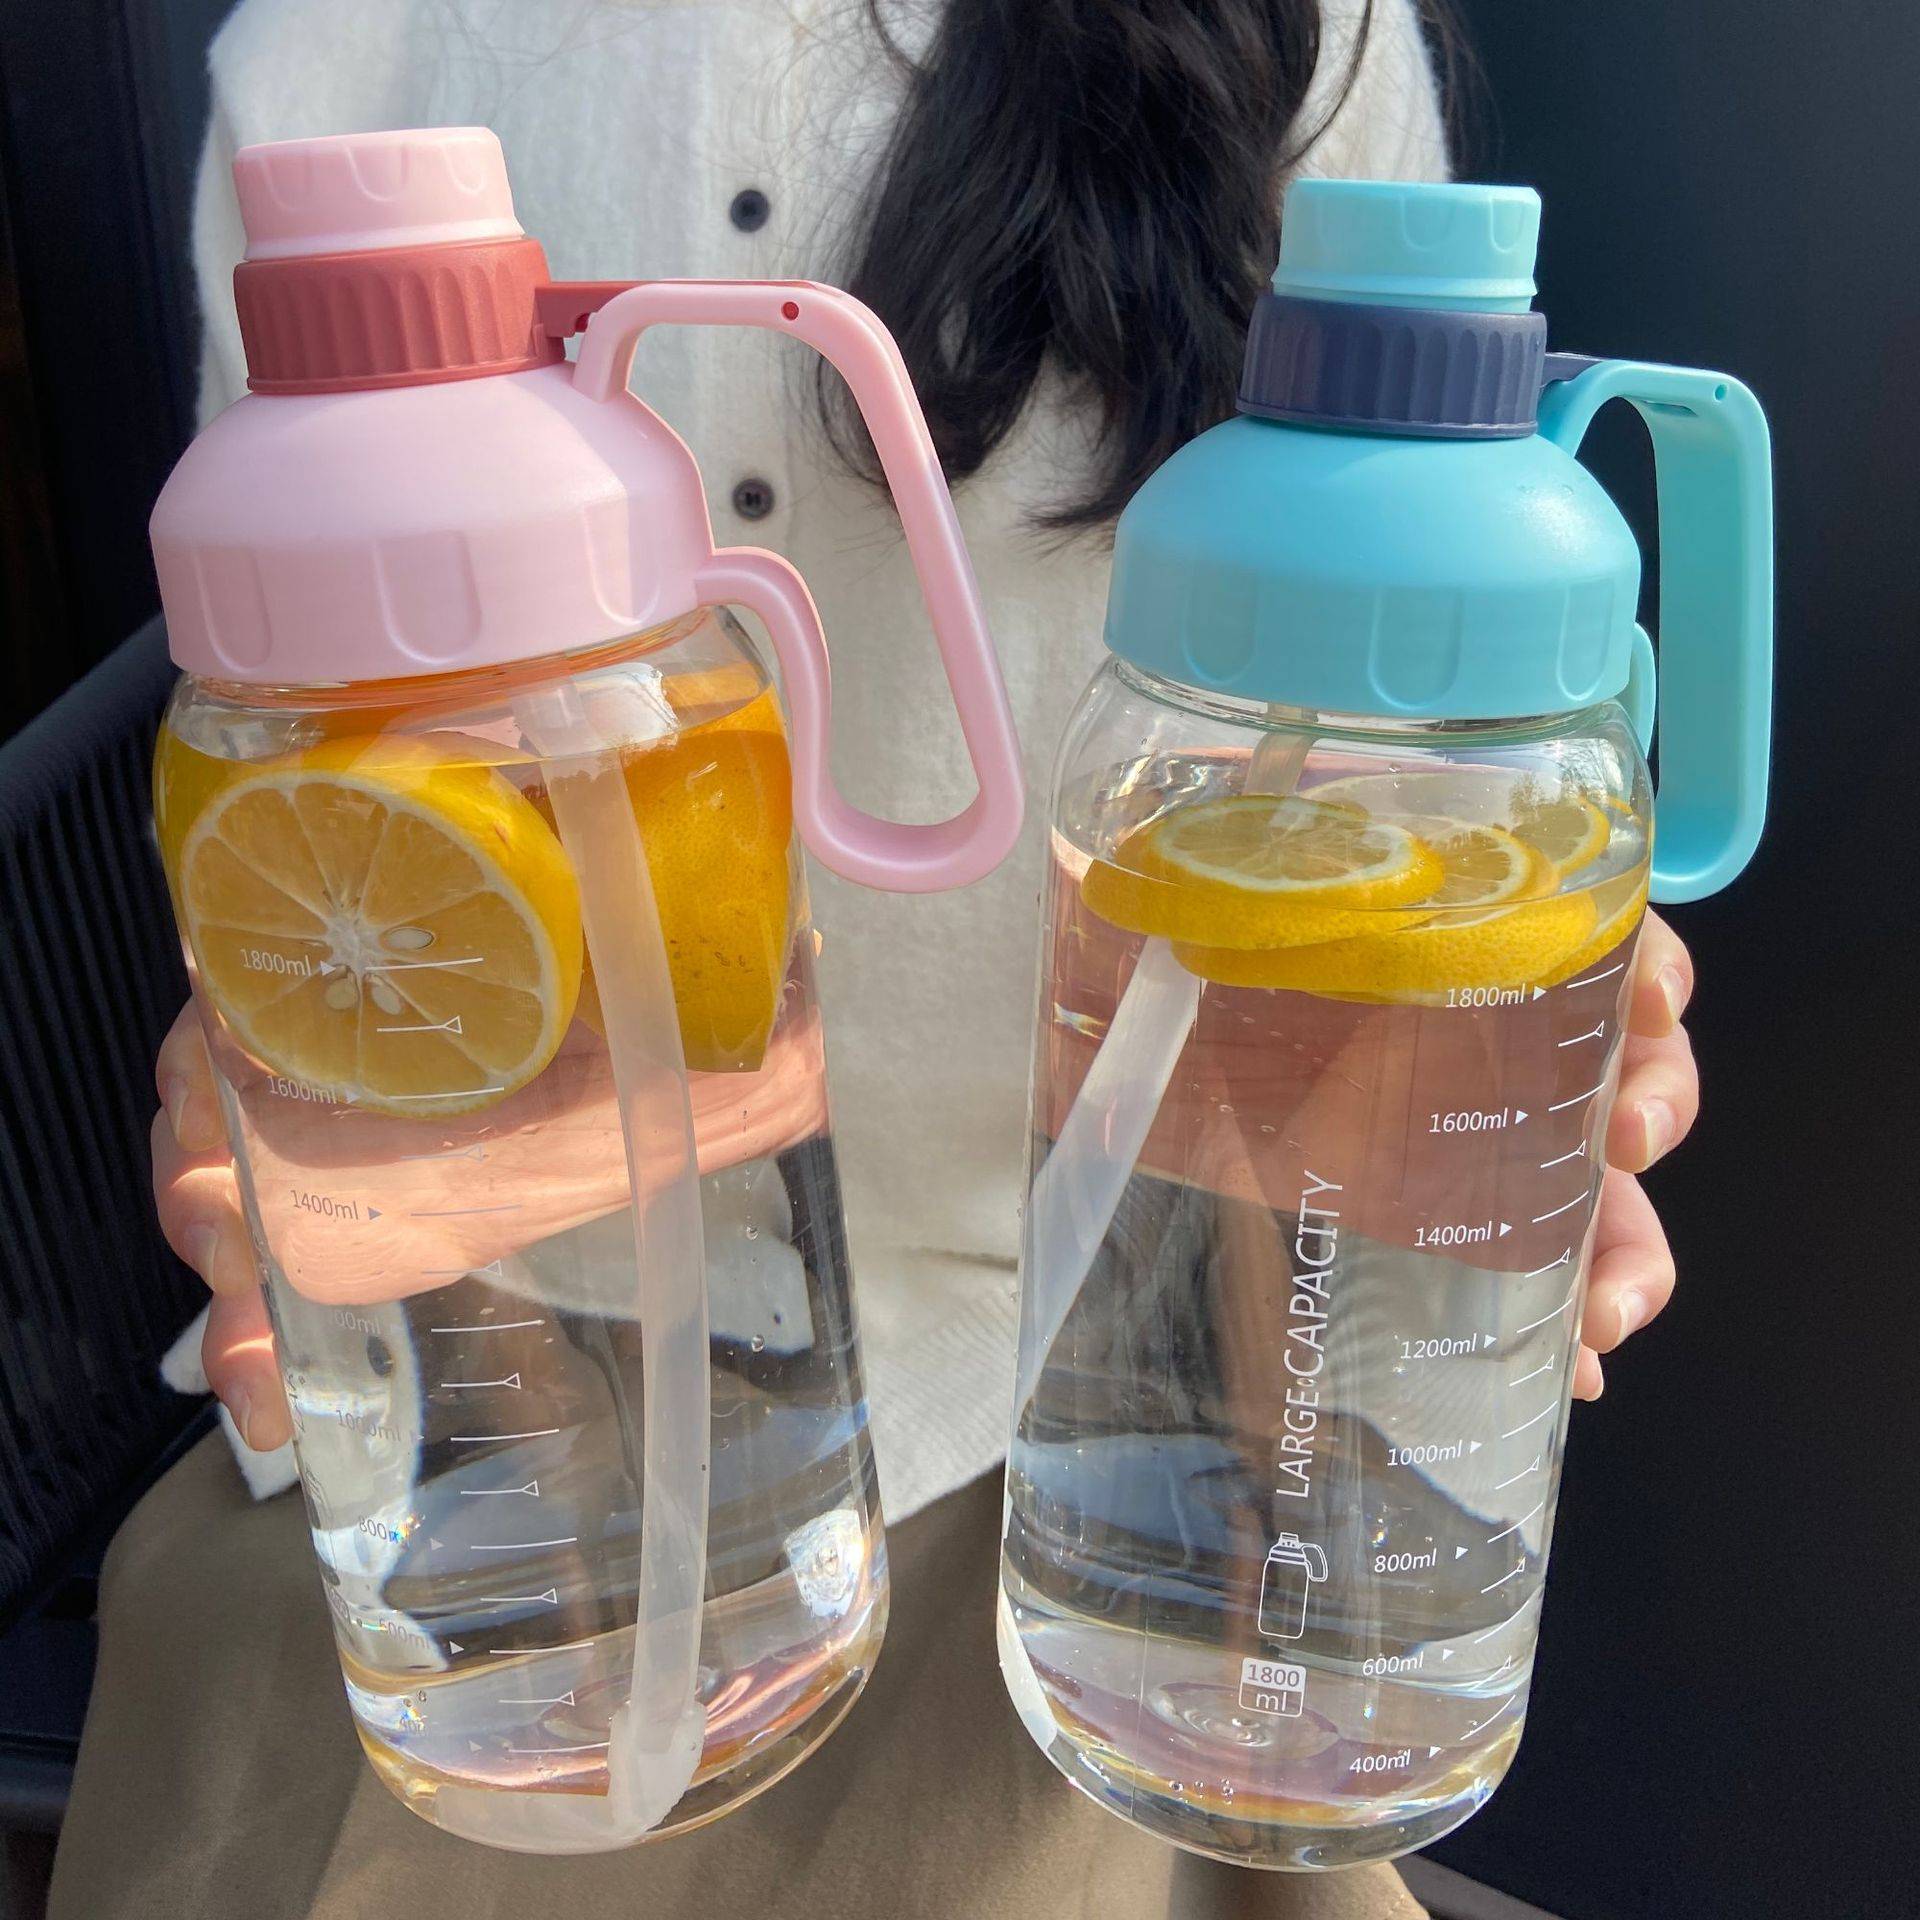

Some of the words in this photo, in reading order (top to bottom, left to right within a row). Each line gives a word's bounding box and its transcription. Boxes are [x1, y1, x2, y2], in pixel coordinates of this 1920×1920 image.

[240, 948, 312, 977] 1800ml
[1445, 983, 1526, 1009] 1800ml
[266, 1075, 338, 1105] 1600ml
[1428, 1108, 1508, 1134] 1600ml
[290, 1189, 359, 1221] 1400ml
[1414, 1220, 1492, 1248] 1400ml
[1283, 1169, 1343, 1378] CAPACITY
[1400, 1333, 1477, 1360] 1200ml
[1276, 1387, 1320, 1499] LARGE
[1386, 1439, 1463, 1467] 1000ml
[1373, 1547, 1437, 1574] 800ml
[1247, 1663, 1300, 1689] 1800
[1362, 1650, 1424, 1677] 600ml
[1255, 1690, 1287, 1712] ml
[1349, 1748, 1411, 1774] 400ml
